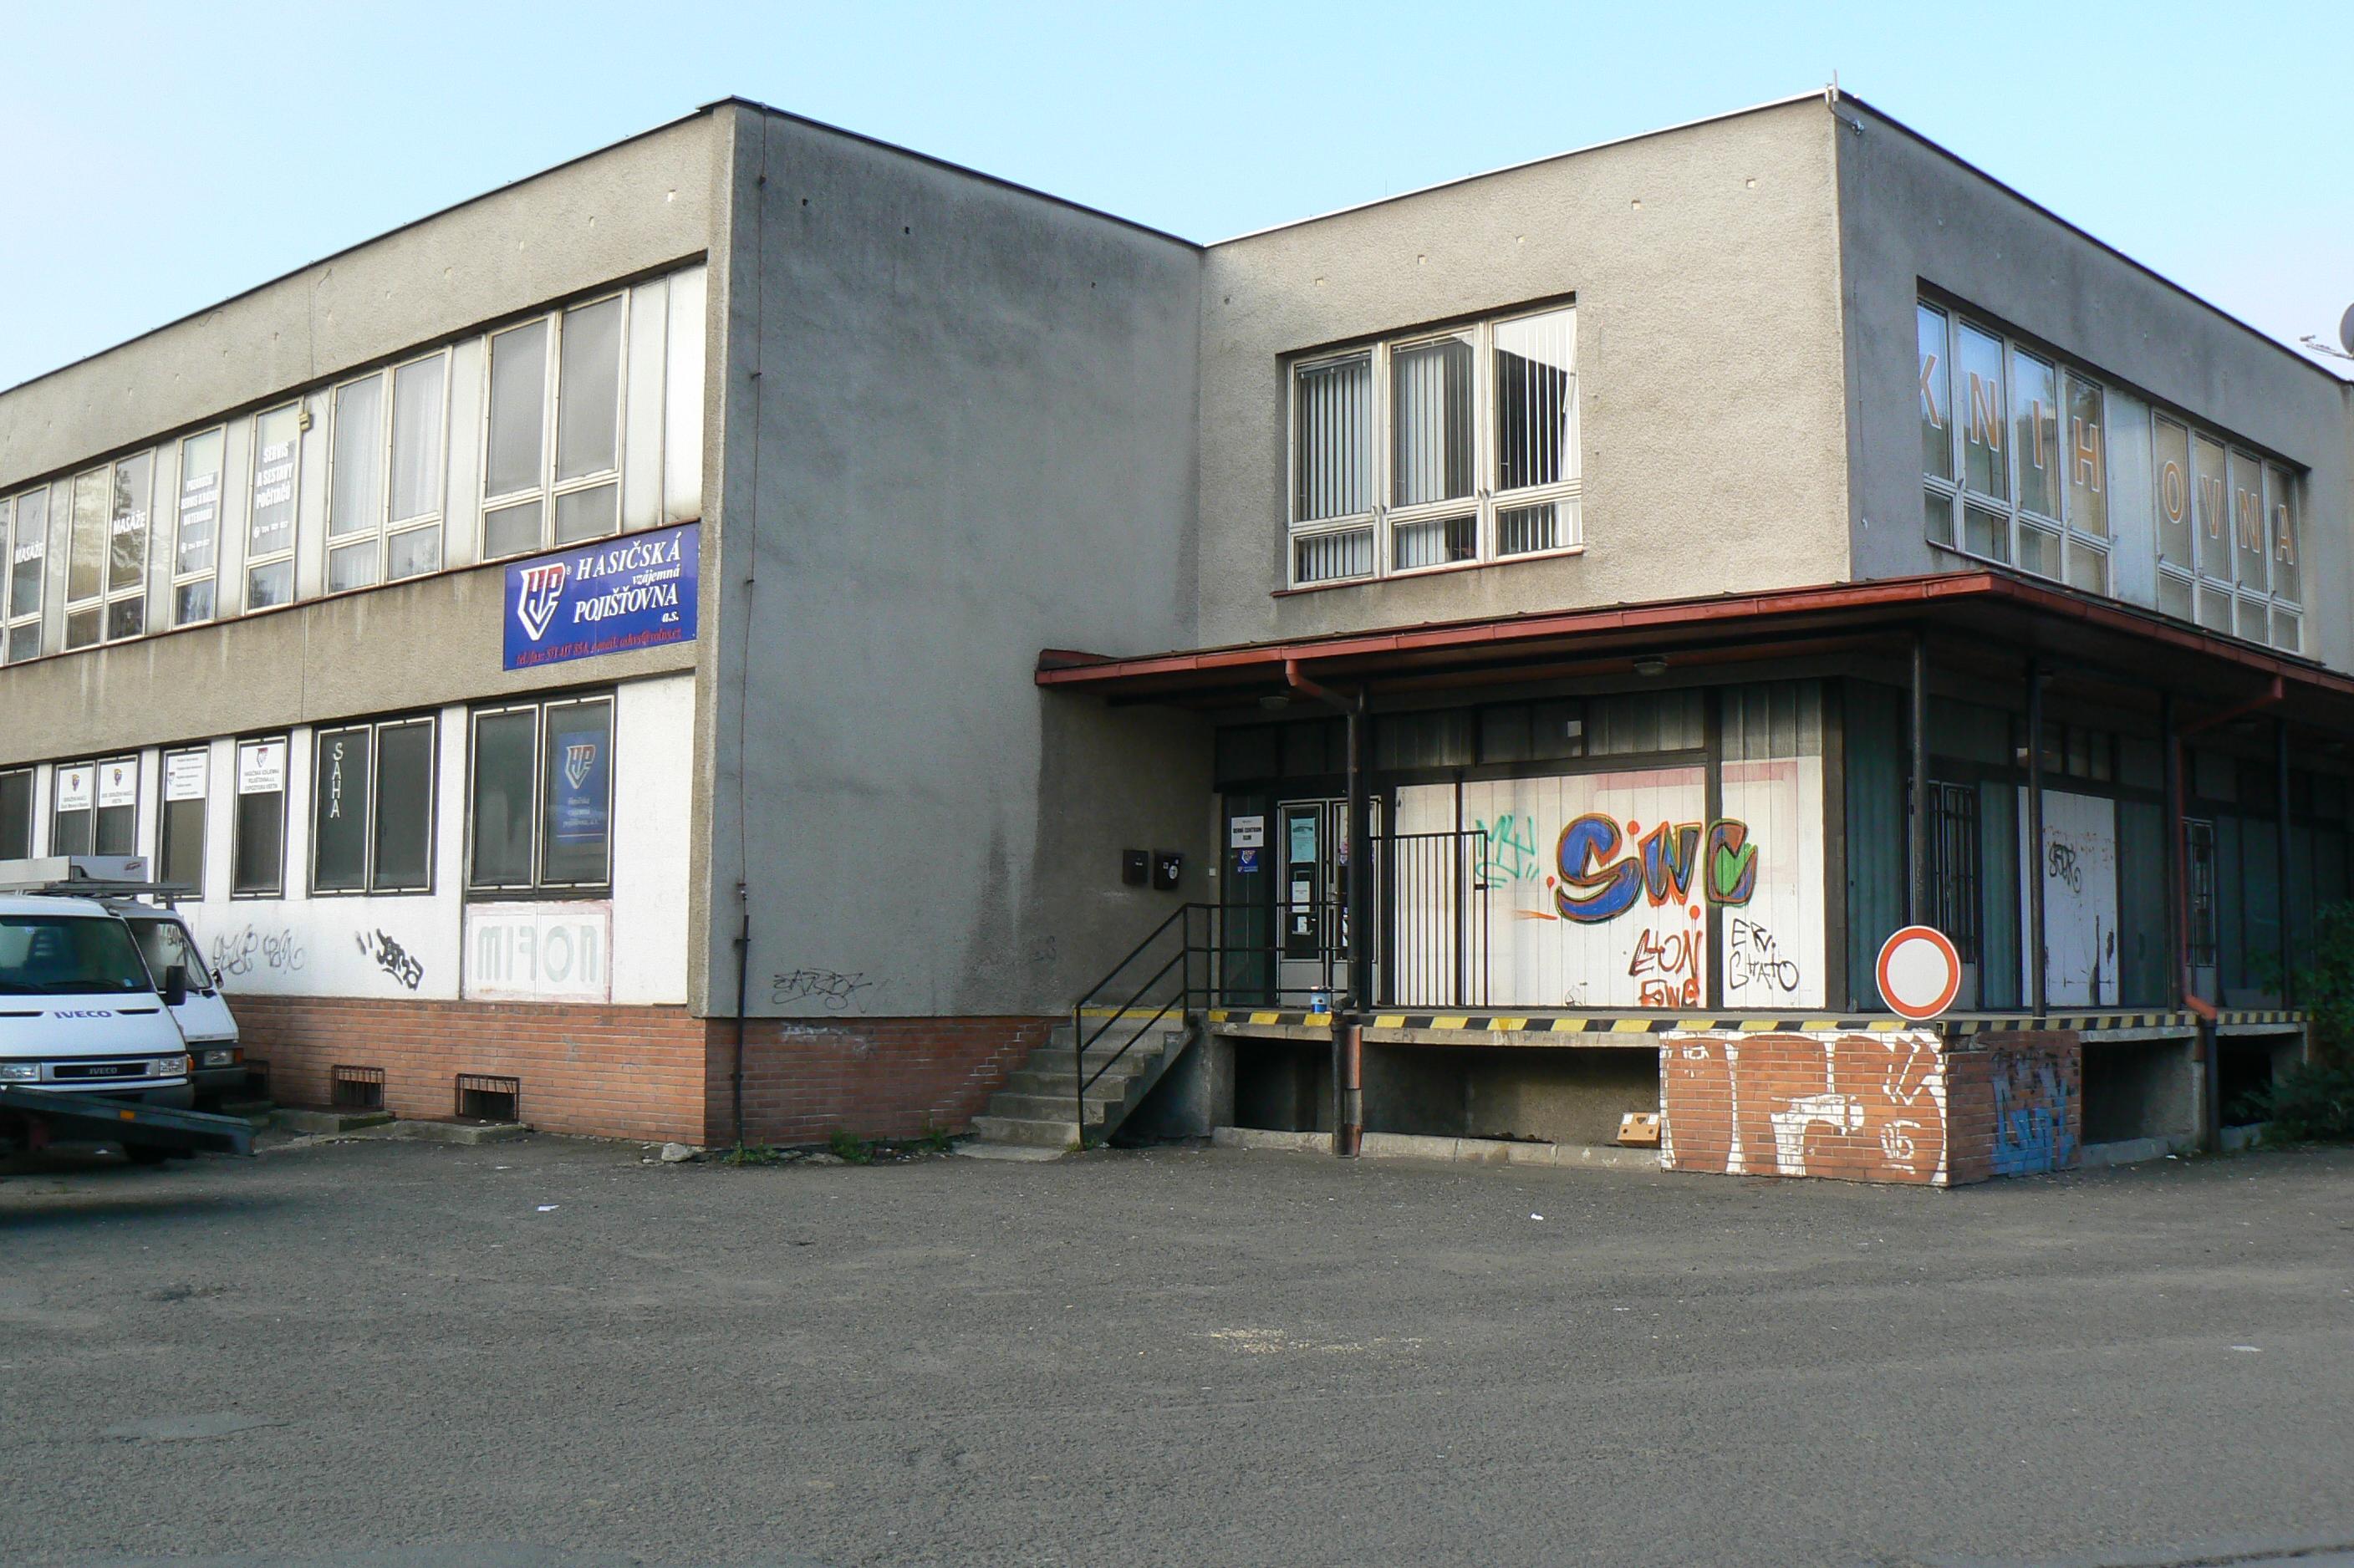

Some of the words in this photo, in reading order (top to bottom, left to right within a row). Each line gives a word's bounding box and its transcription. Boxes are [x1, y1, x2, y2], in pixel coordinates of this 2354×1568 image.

[113, 510, 146, 535] MASÁŽE
[14, 540, 43, 564] MASÁŽE
[575, 531, 683, 581] HASIČSKÁ
[632, 564, 680, 586] vzájemná
[573, 583, 679, 624] POJIŠŤOVNA
[661, 610, 680, 623] a.s.
[54, 1010, 113, 1019] IVECO
[89, 1067, 118, 1075] IVECO
